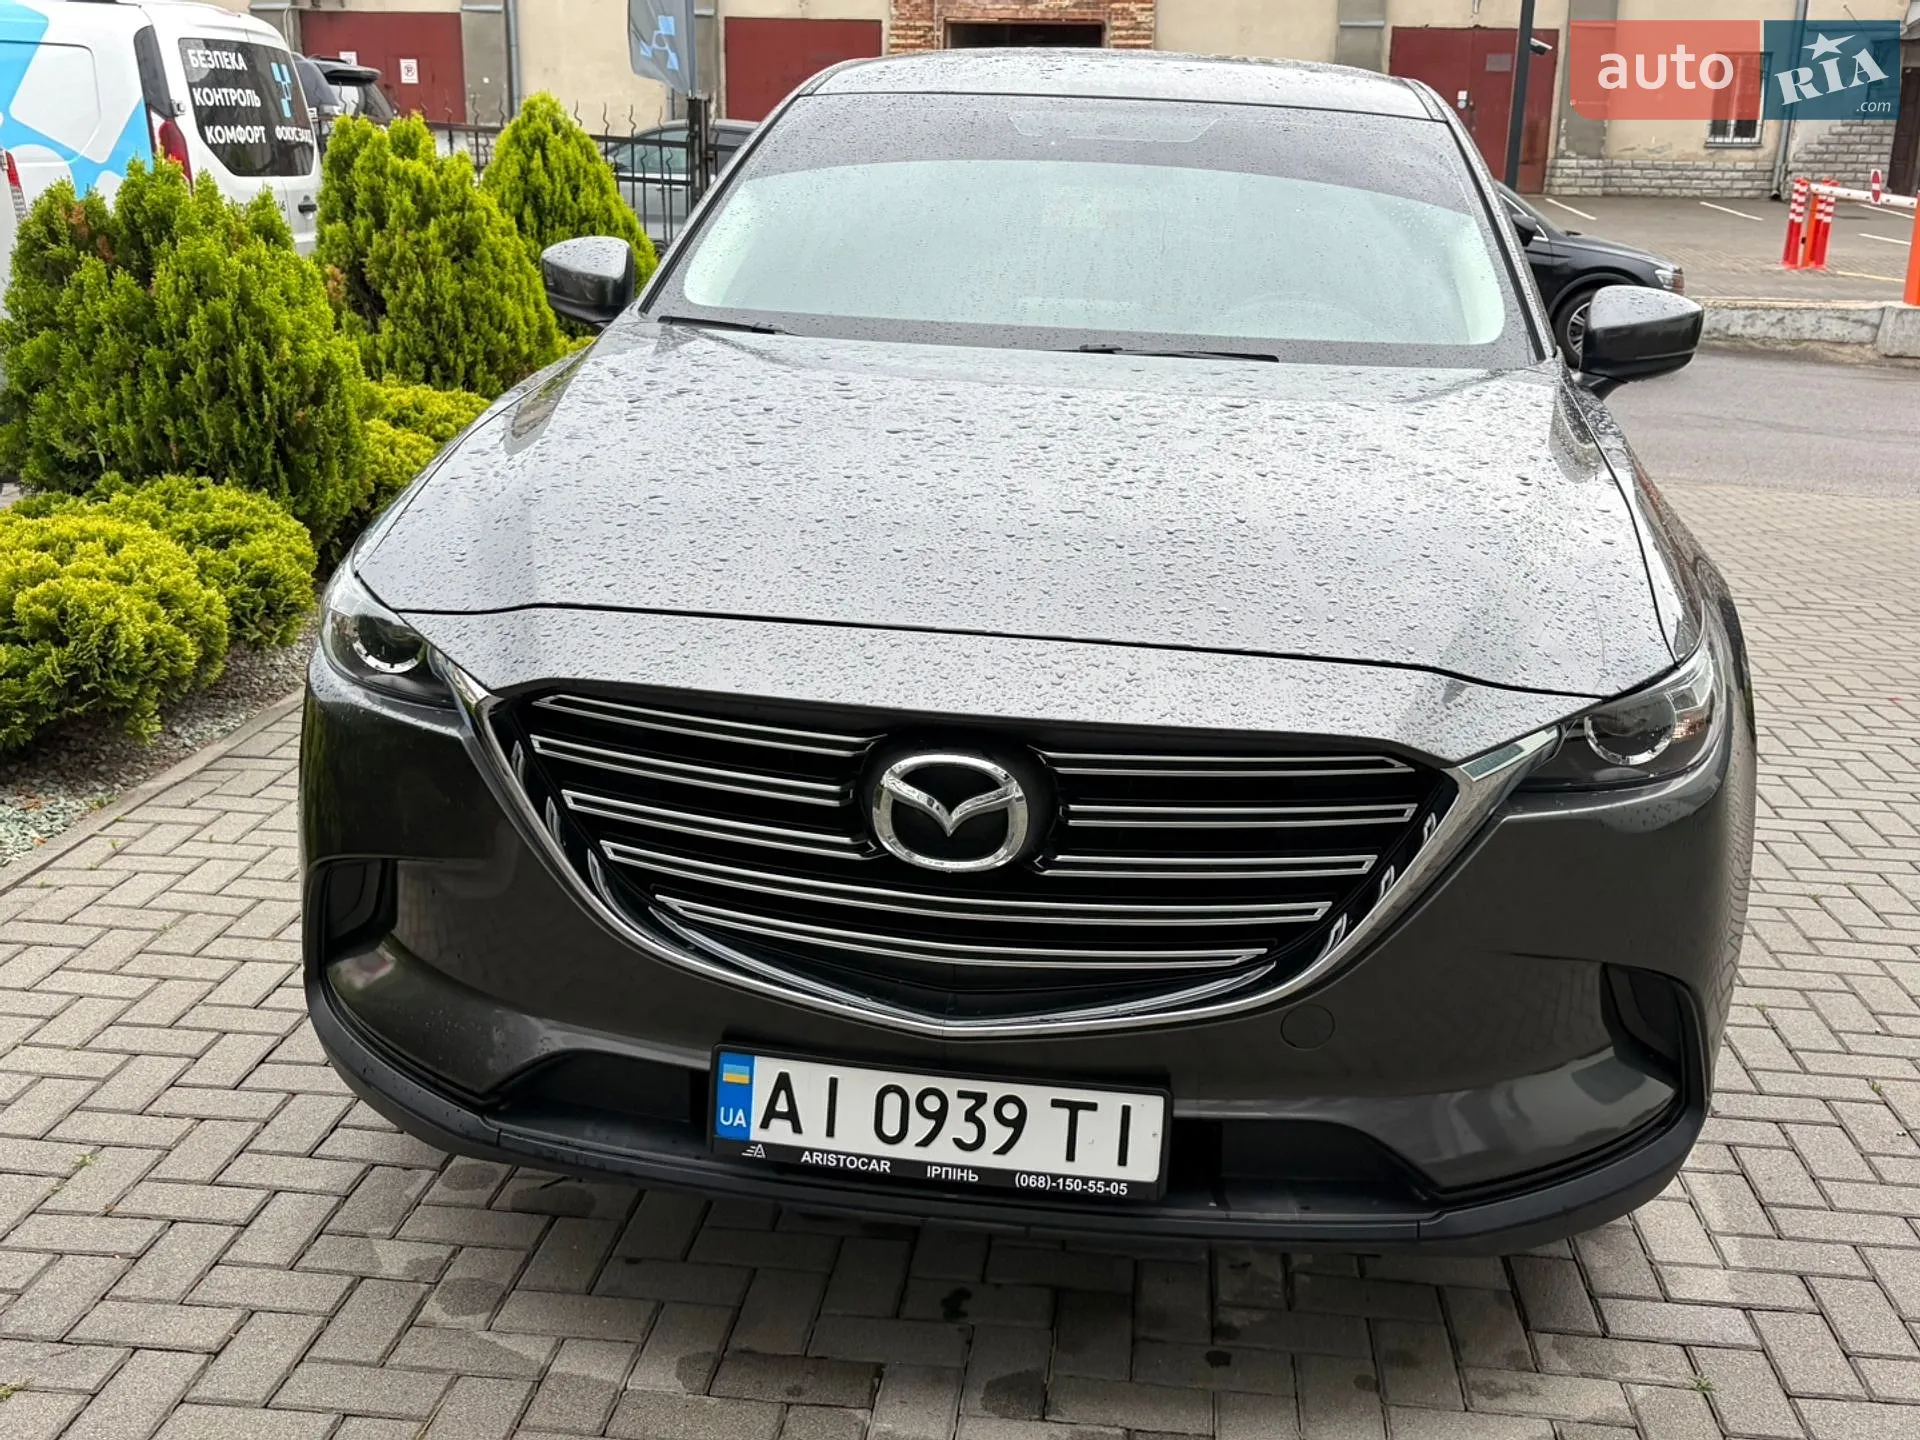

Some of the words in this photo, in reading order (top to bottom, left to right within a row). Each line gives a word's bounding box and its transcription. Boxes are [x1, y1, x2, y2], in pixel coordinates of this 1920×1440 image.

[187, 49, 248, 71] БЕЗПЕКА
[192, 87, 261, 108] КОНТРОЛЬ
[204, 125, 267, 144] КОМФОРТ
[719, 1106, 747, 1128] UA
[873, 1083, 1028, 1156] 0939
[801, 1150, 891, 1173] ARISTOCAR
[926, 1165, 979, 1182] ІРПІНЬ
[1014, 1172, 1128, 1196] (068)-150-55-05
